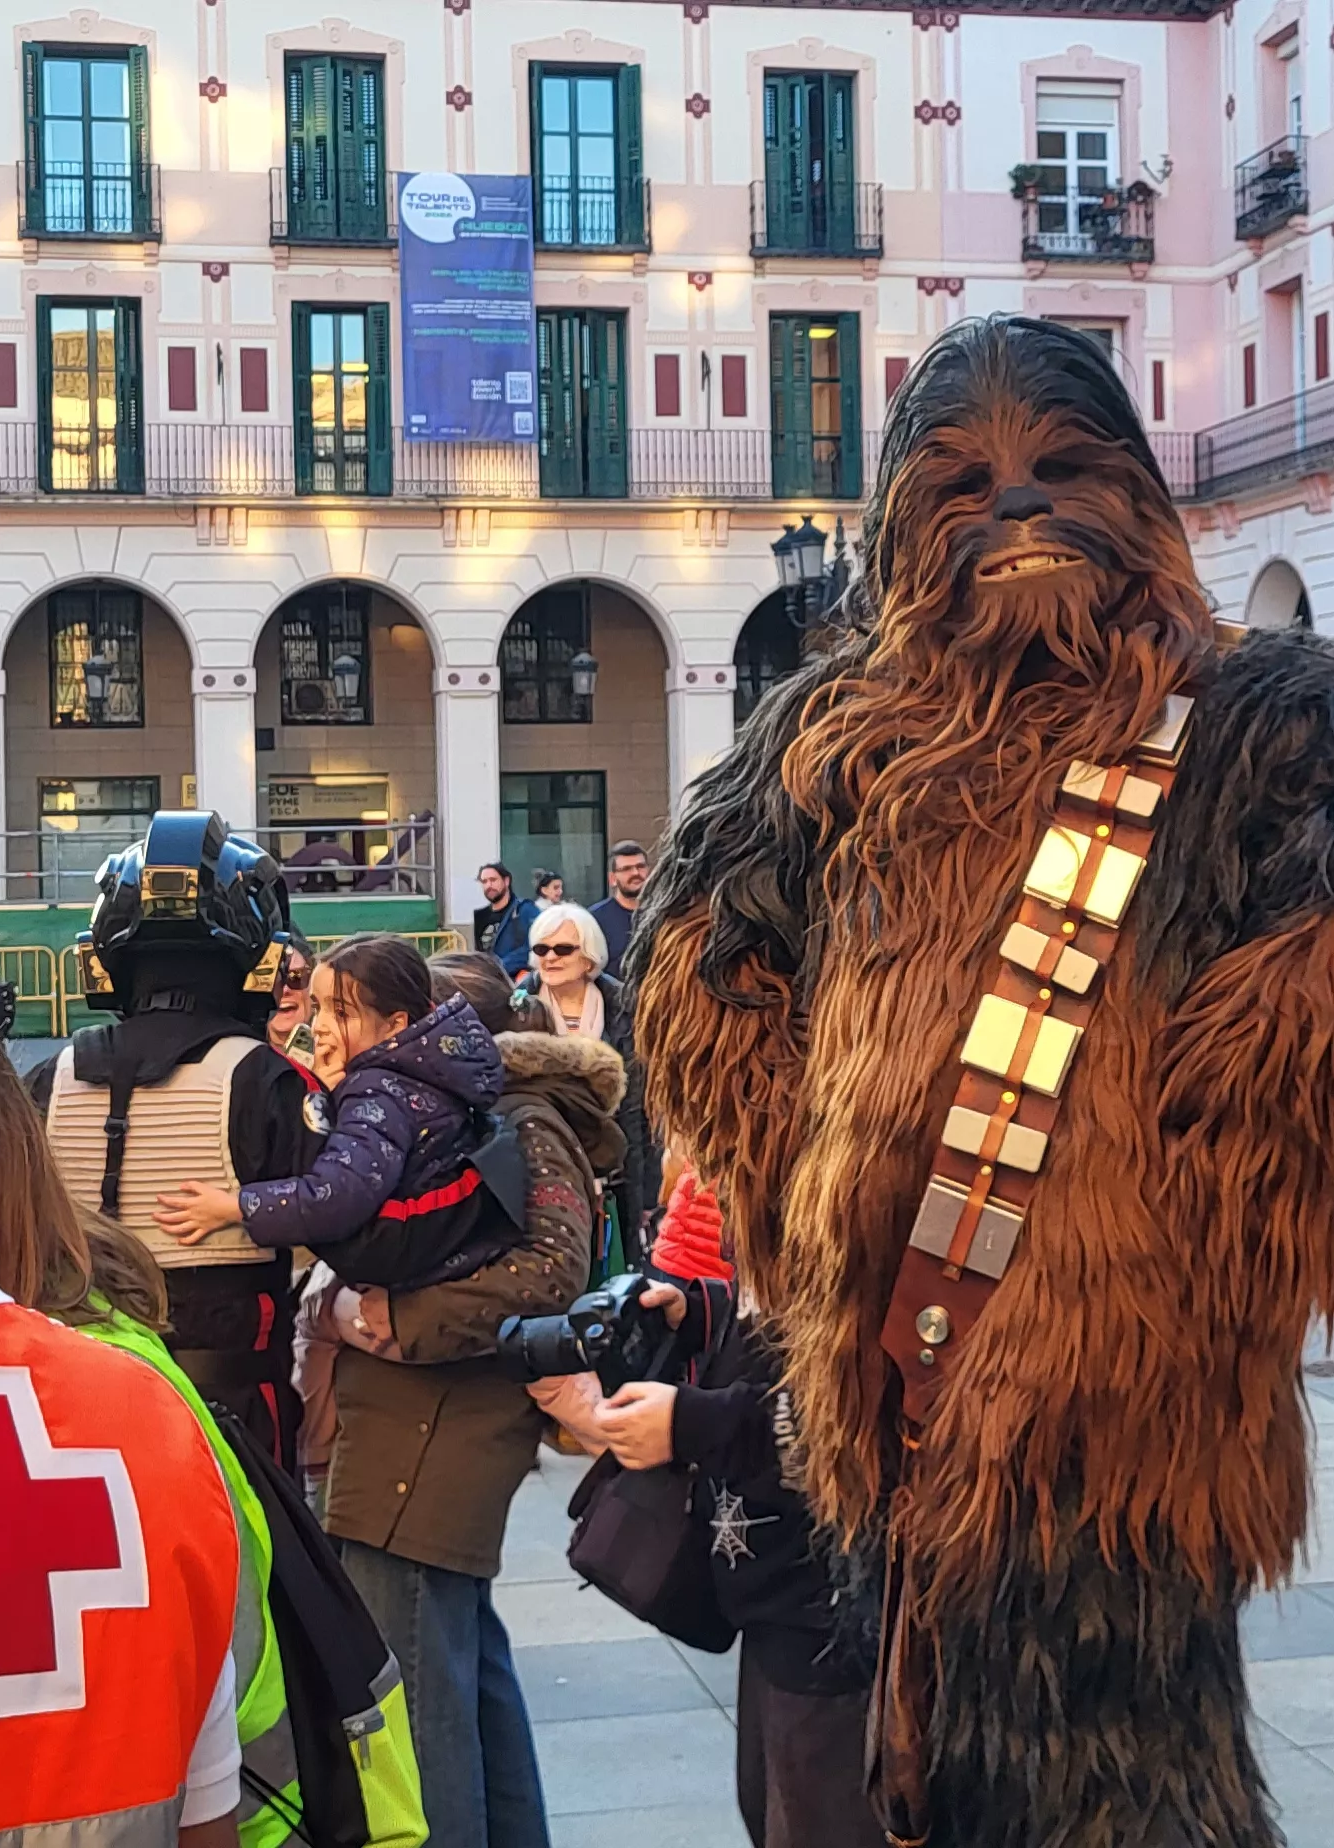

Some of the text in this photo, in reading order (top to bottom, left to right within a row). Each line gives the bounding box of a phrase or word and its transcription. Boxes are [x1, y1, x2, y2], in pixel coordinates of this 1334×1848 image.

[406, 192, 451, 203] TOUR
[453, 195, 471, 203] DEL
[406, 202, 472, 212] TALENTO
